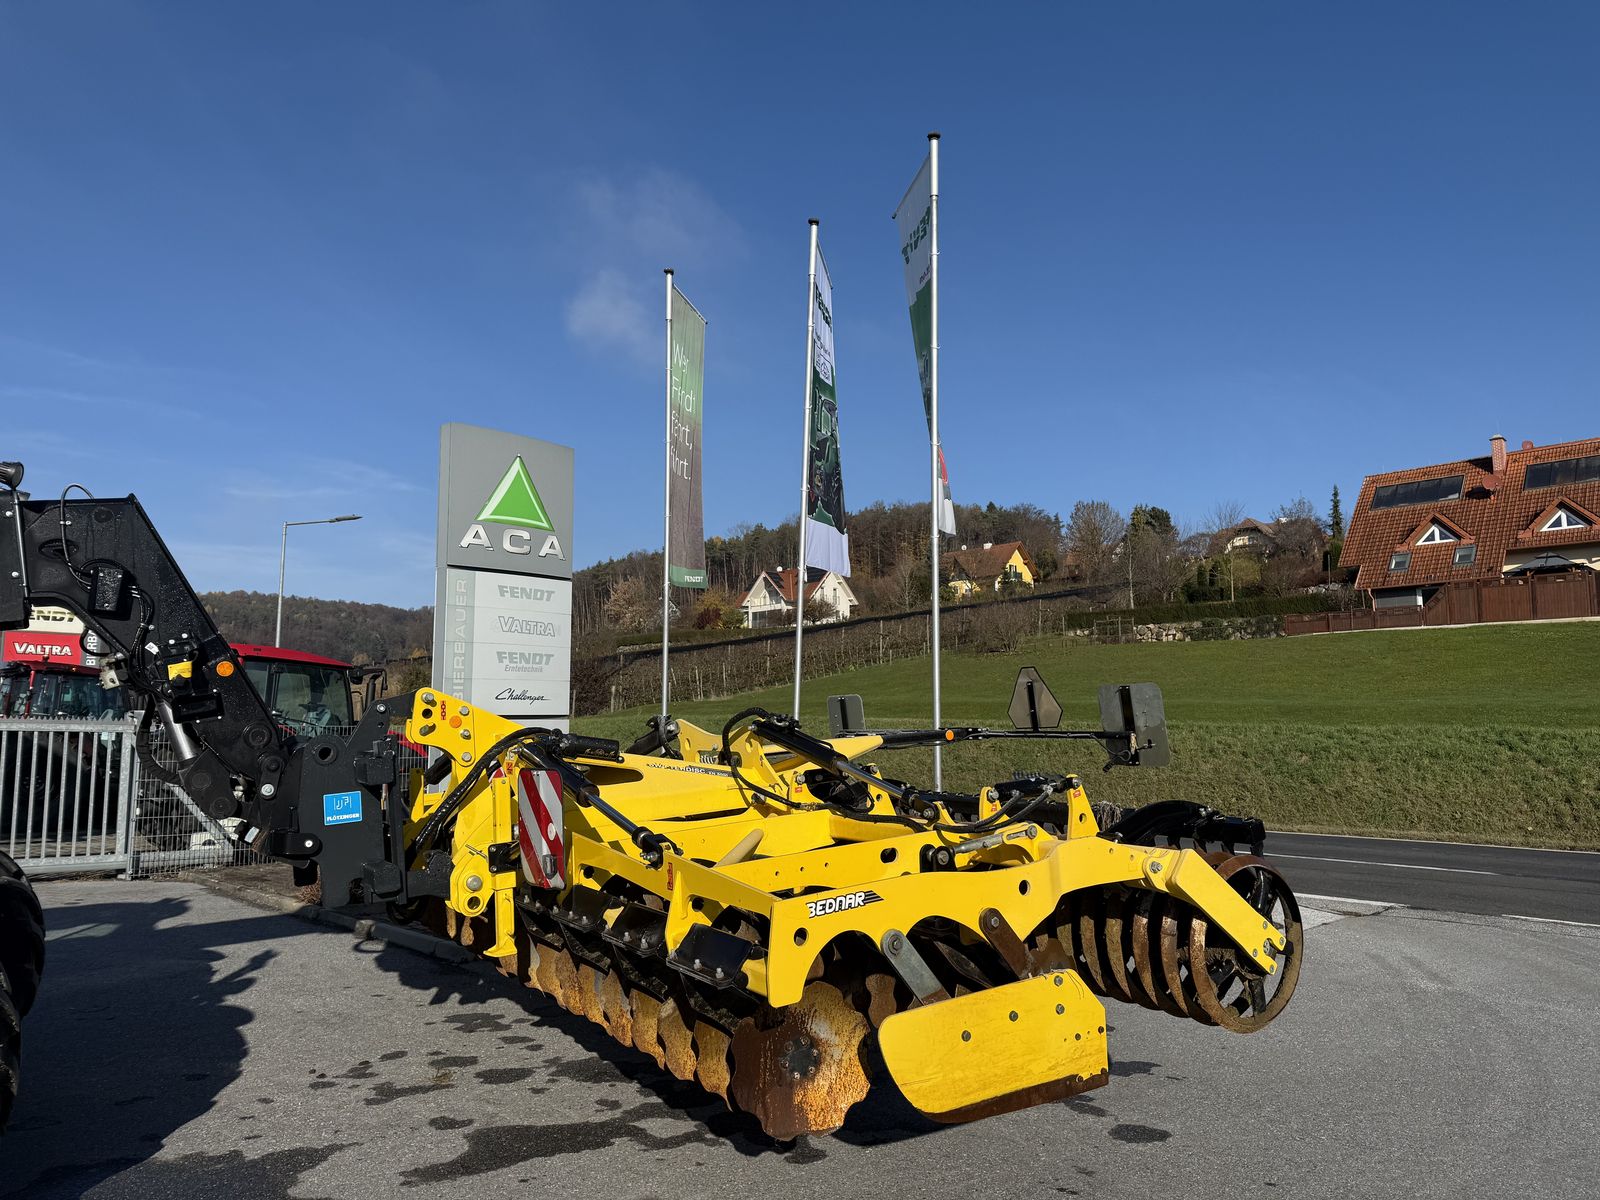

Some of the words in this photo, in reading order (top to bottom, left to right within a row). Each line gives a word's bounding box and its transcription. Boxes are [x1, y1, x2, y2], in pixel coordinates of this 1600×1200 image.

[458, 523, 566, 561] ACA
[498, 585, 555, 602] FENDT
[28, 610, 75, 622] ENDT
[498, 616, 555, 637] VALTRA
[13, 642, 72, 656] VALTRA
[85, 629, 98, 666] BIRB
[496, 651, 554, 665] FENDT
[504, 664, 543, 673] Erntetechnik
[495, 687, 551, 705] Challenger
[807, 891, 865, 918] BEDNAR
